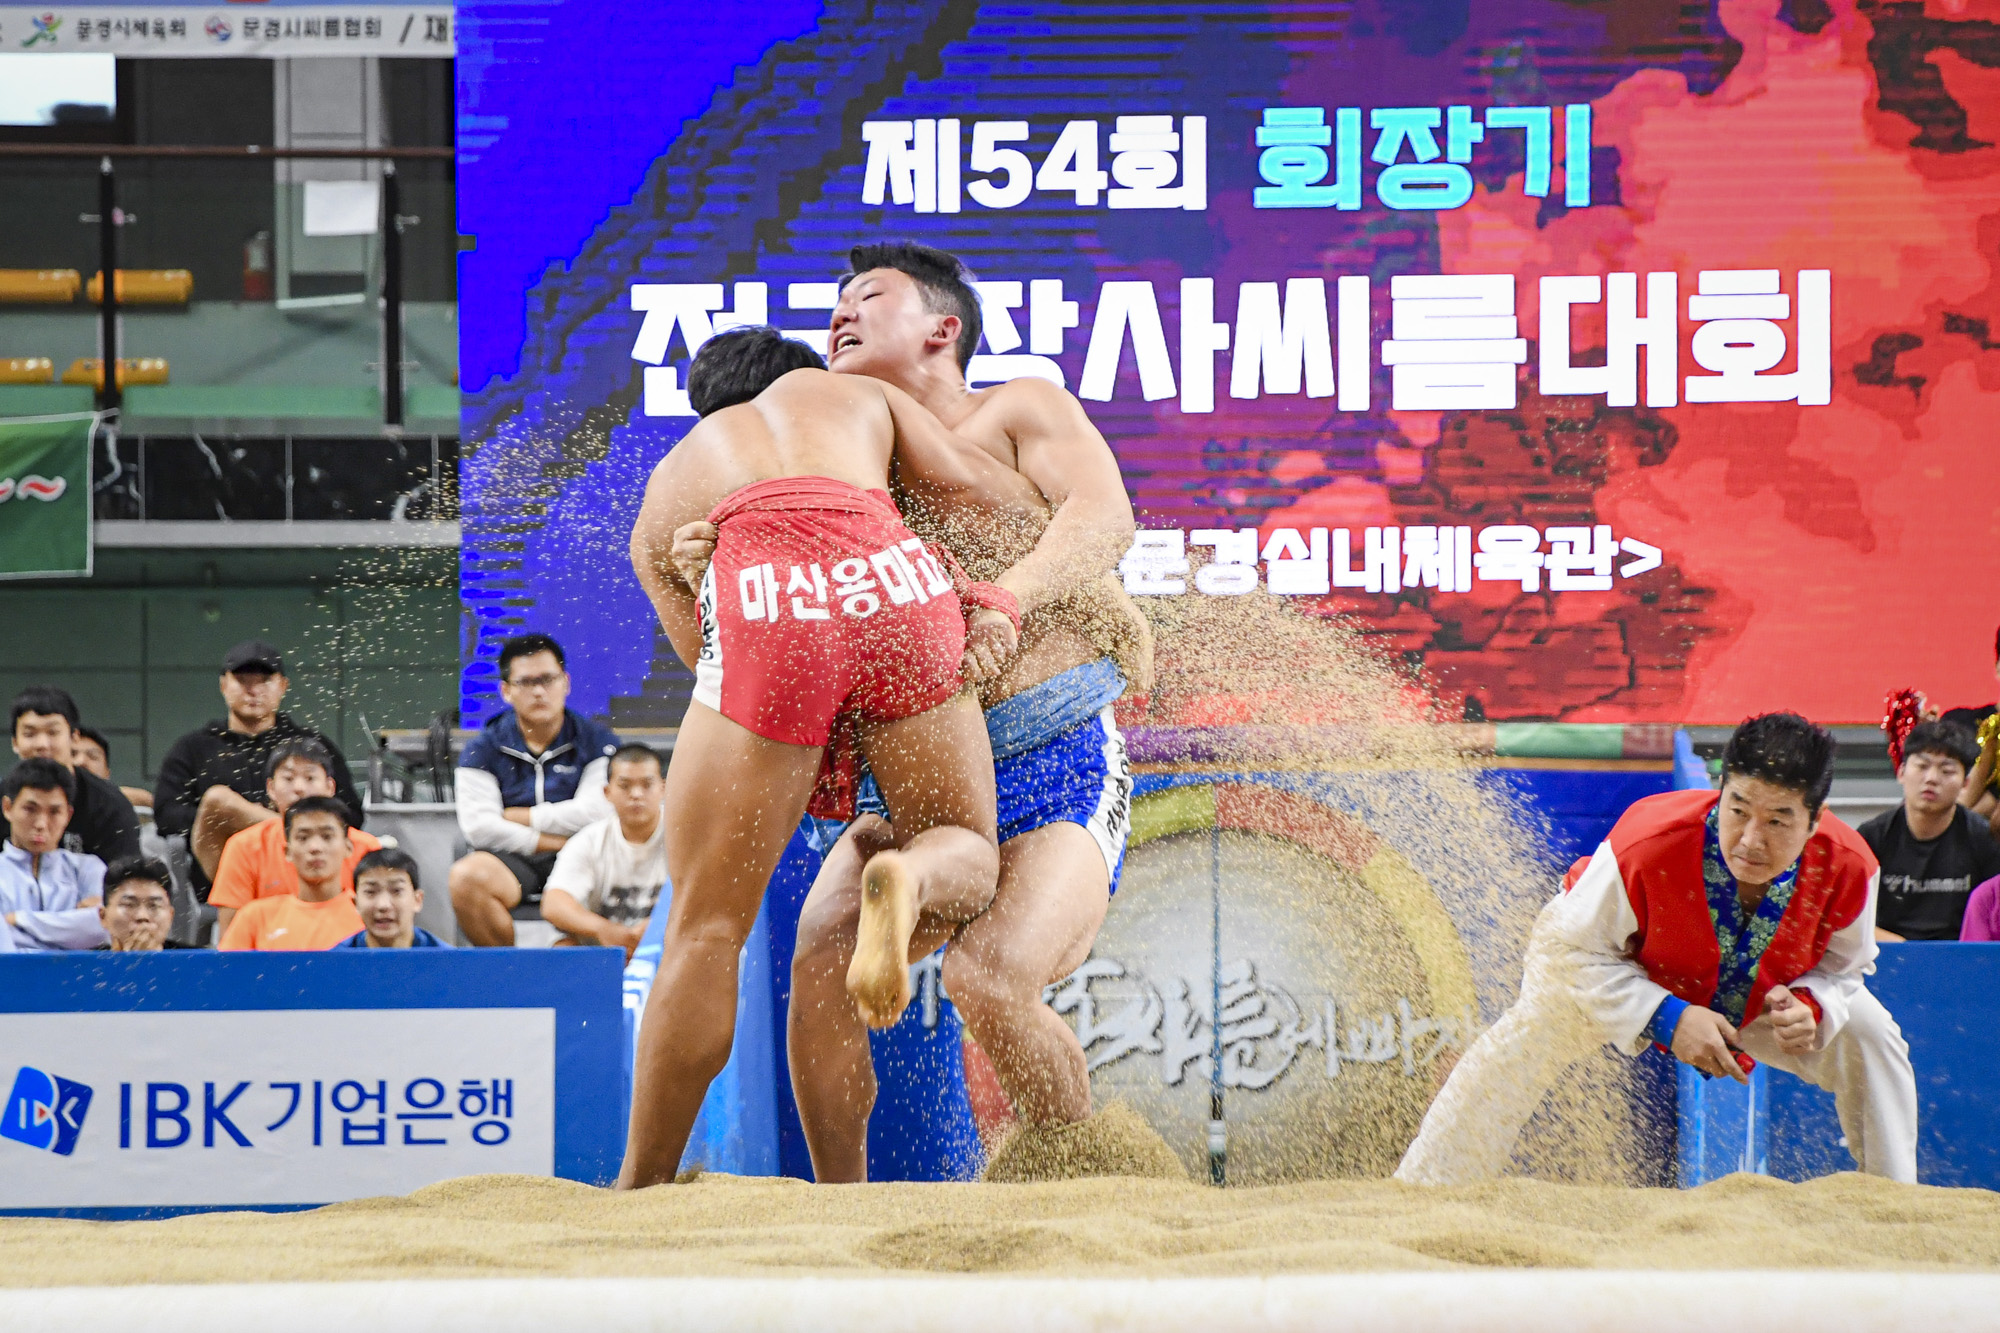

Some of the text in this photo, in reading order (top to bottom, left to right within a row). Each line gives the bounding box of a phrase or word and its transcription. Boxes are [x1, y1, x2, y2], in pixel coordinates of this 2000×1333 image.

[243, 17, 382, 41] 문경시씨름협회
[862, 104, 1591, 213] 제54회 회장기
[631, 269, 1831, 417] 전장사씨름대회
